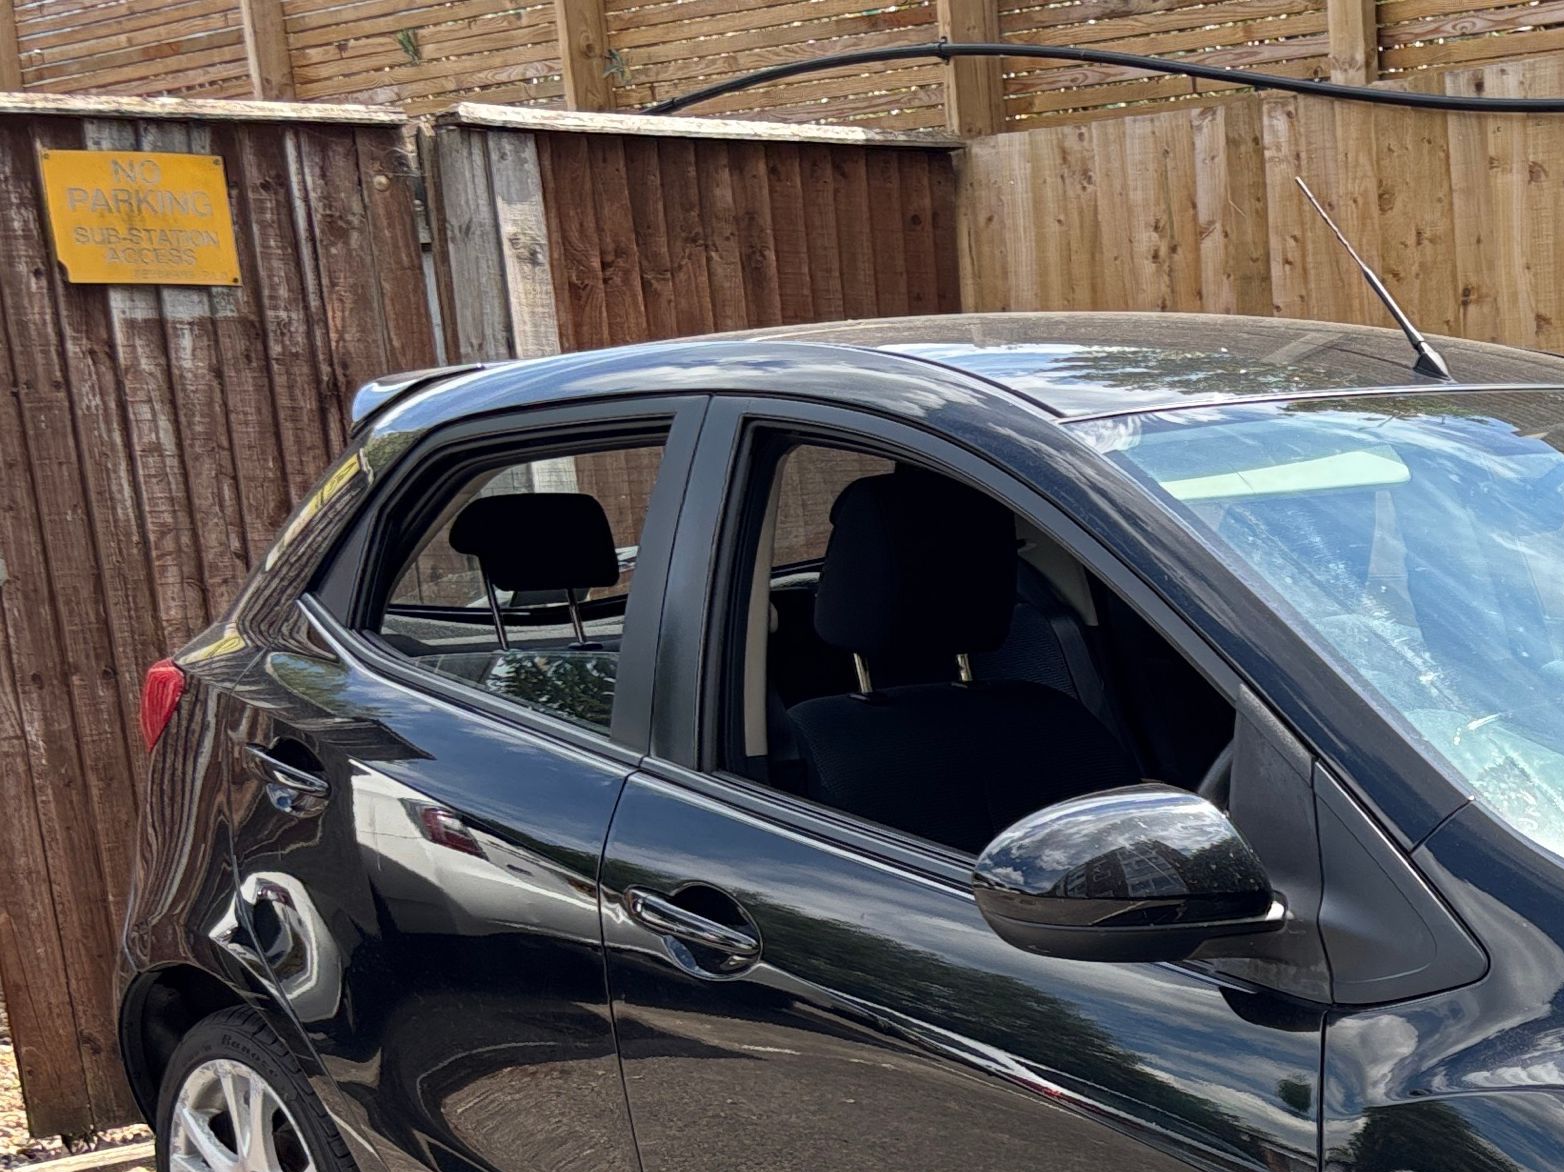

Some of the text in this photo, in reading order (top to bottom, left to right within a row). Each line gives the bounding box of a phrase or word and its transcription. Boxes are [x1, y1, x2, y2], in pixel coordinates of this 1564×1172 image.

[111, 159, 162, 186] NO
[66, 187, 213, 218] PARKING
[73, 226, 220, 248] SUB-STATION
[106, 248, 198, 266] ACCESS
